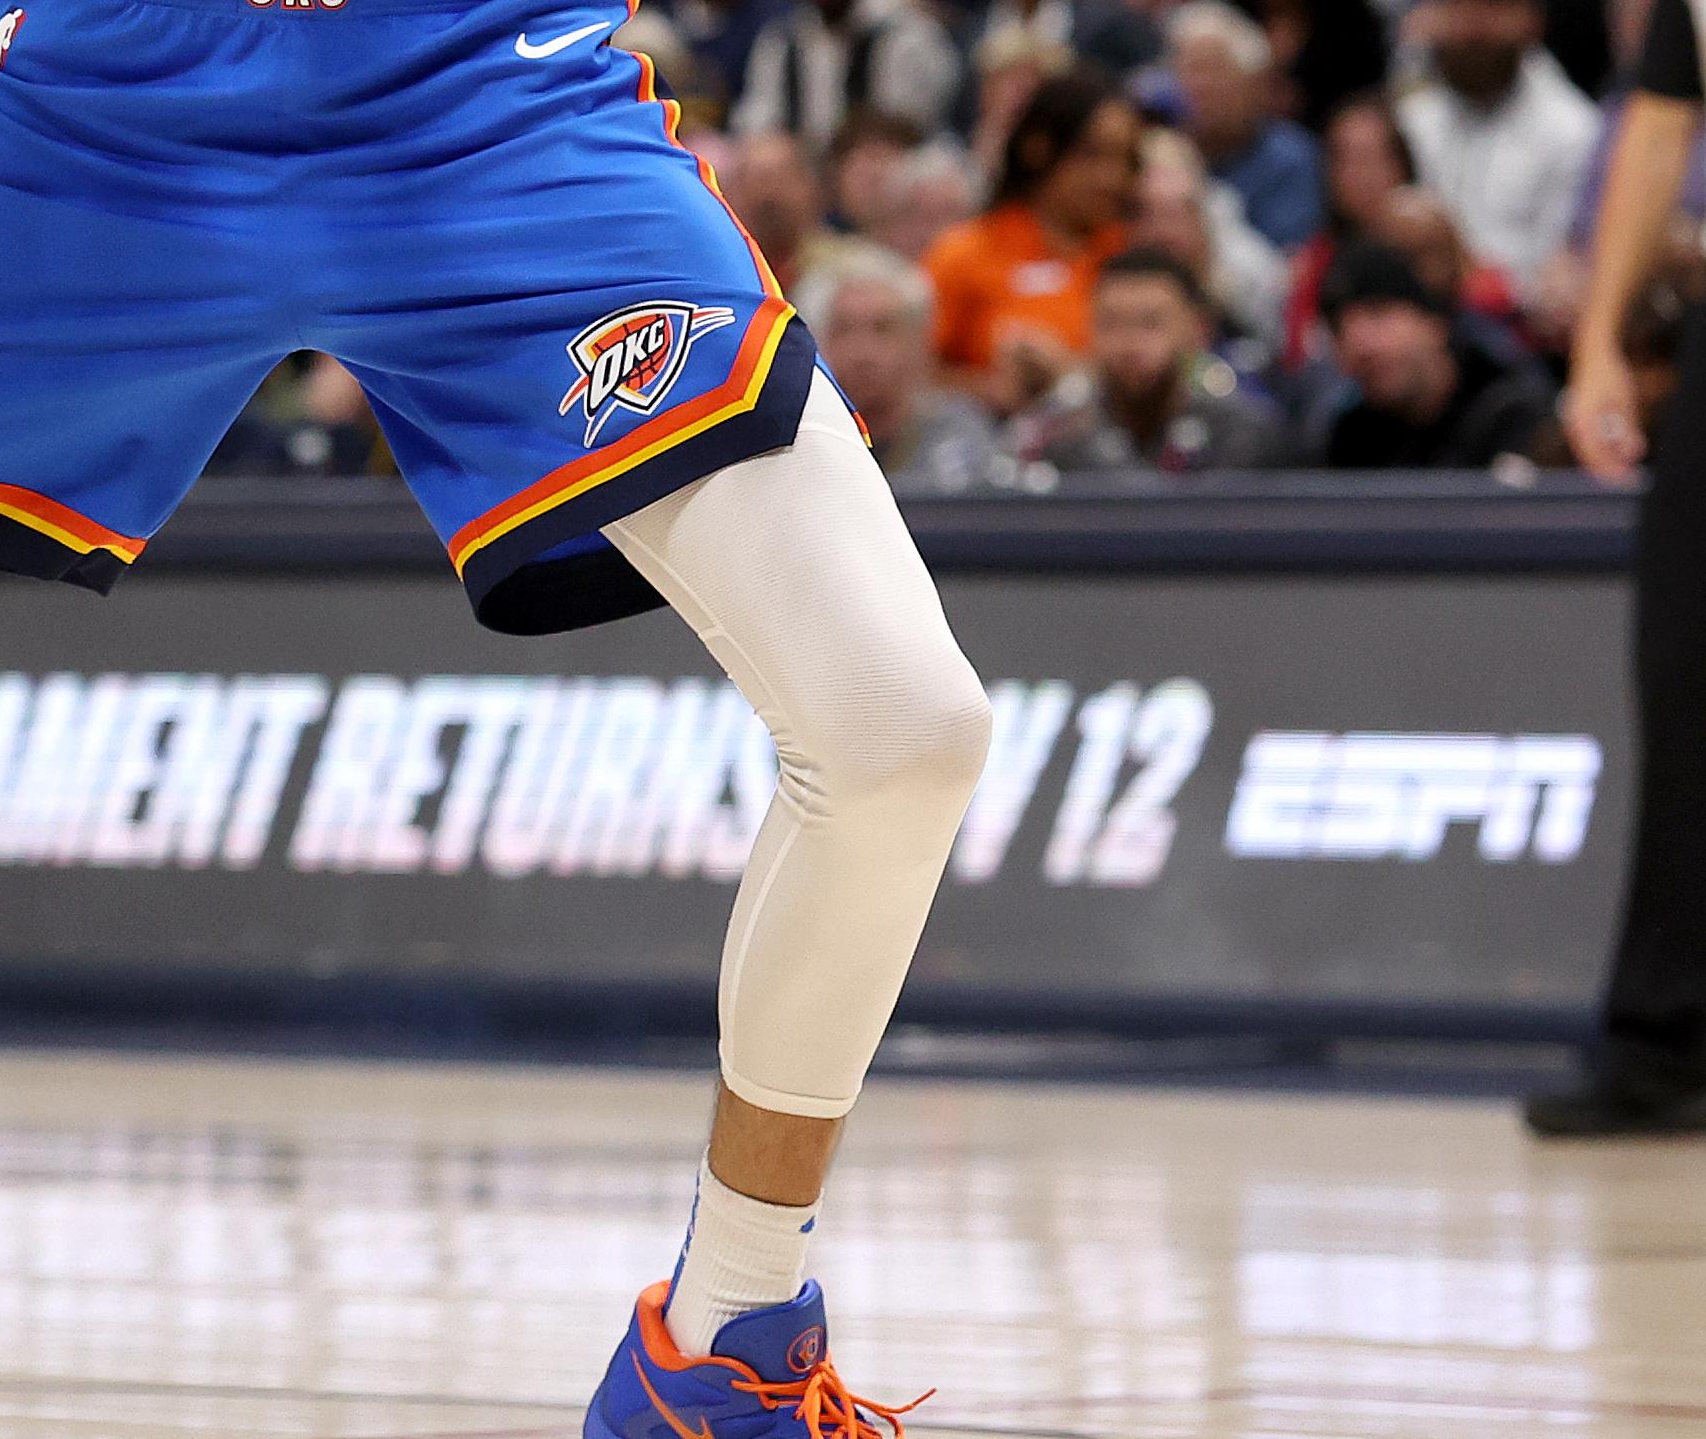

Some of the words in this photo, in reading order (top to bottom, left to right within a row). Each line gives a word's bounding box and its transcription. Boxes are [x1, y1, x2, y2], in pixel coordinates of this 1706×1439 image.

[588, 318, 666, 411] OKC
[1044, 676, 1215, 888] 12
[1223, 729, 1602, 862] ESPN
